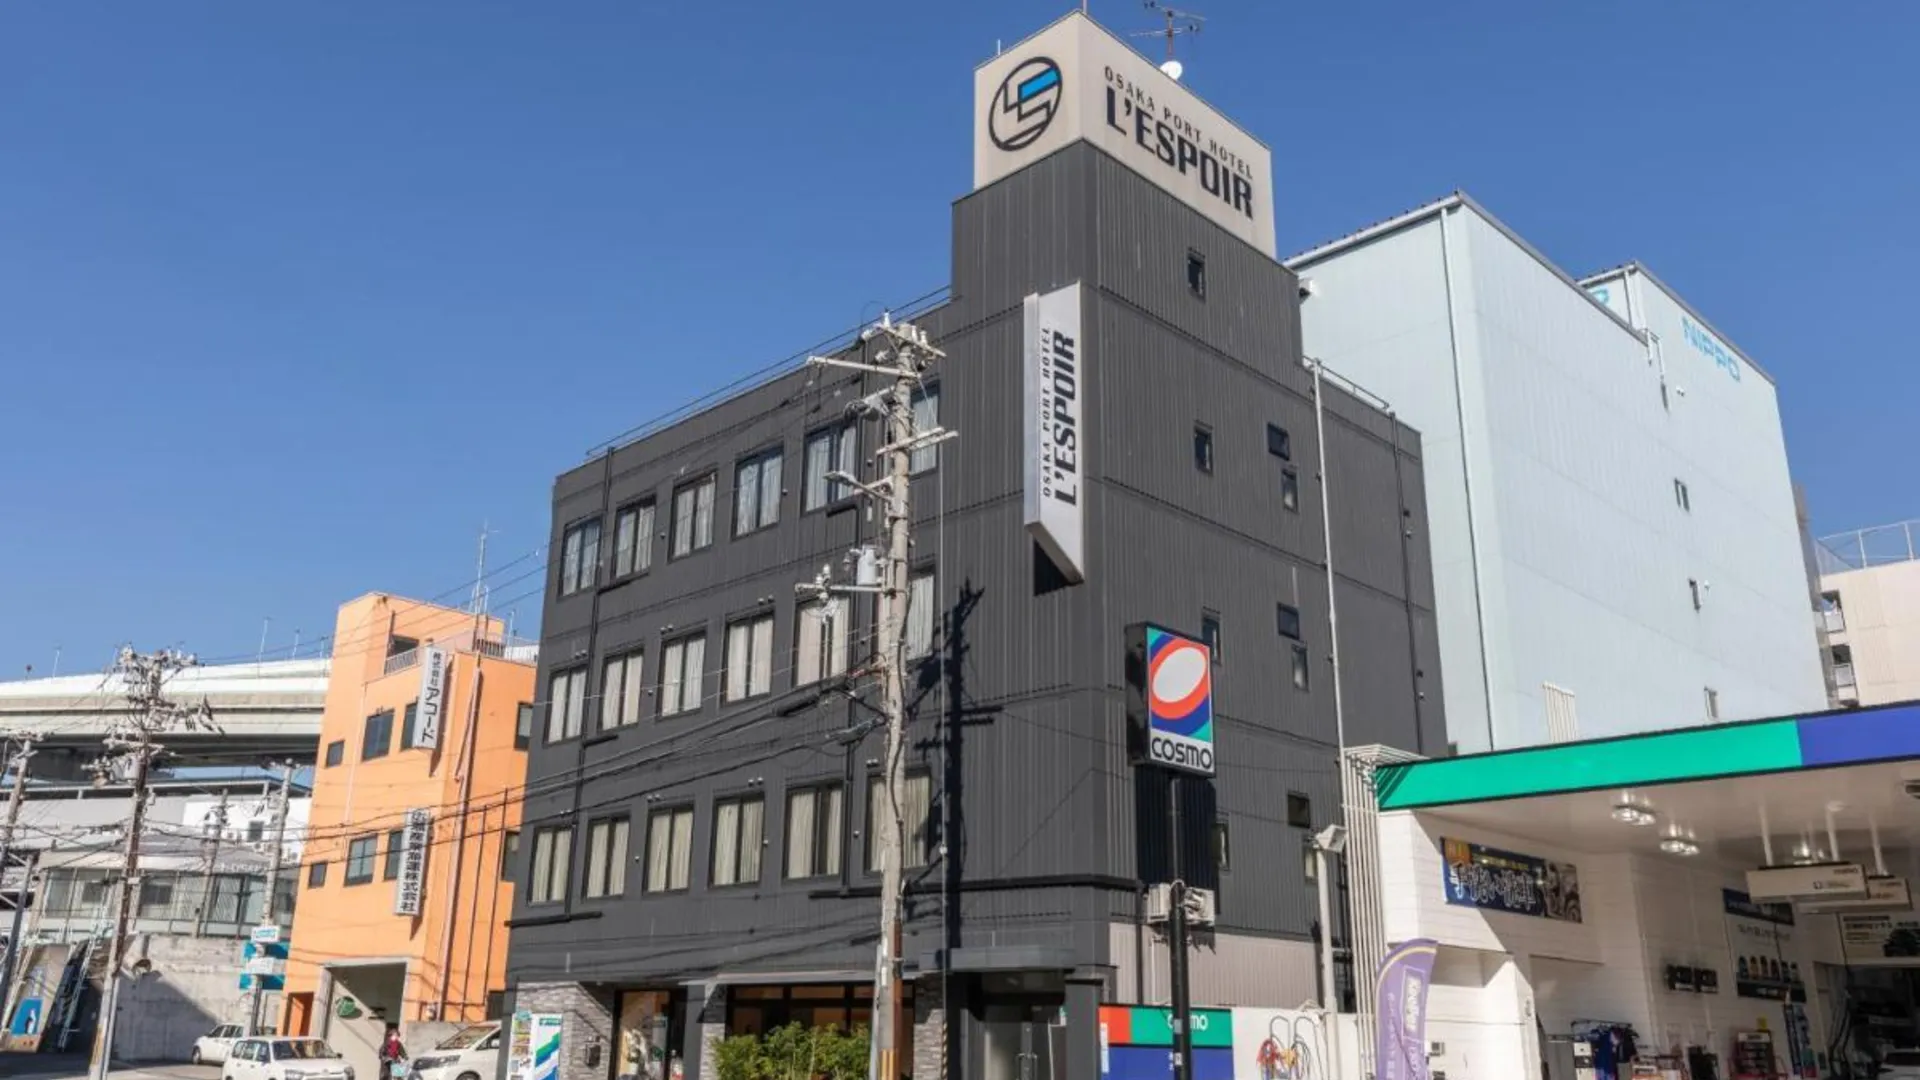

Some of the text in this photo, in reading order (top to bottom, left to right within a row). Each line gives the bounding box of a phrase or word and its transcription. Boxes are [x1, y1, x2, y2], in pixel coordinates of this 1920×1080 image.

[1105, 66, 1253, 180] OSAKA PORT HOTEL
[1105, 86, 1253, 220] L'ESPOIR
[1041, 328, 1051, 498] OSAKA PORT HOTEL
[1053, 330, 1077, 506] L'ESPOIR
